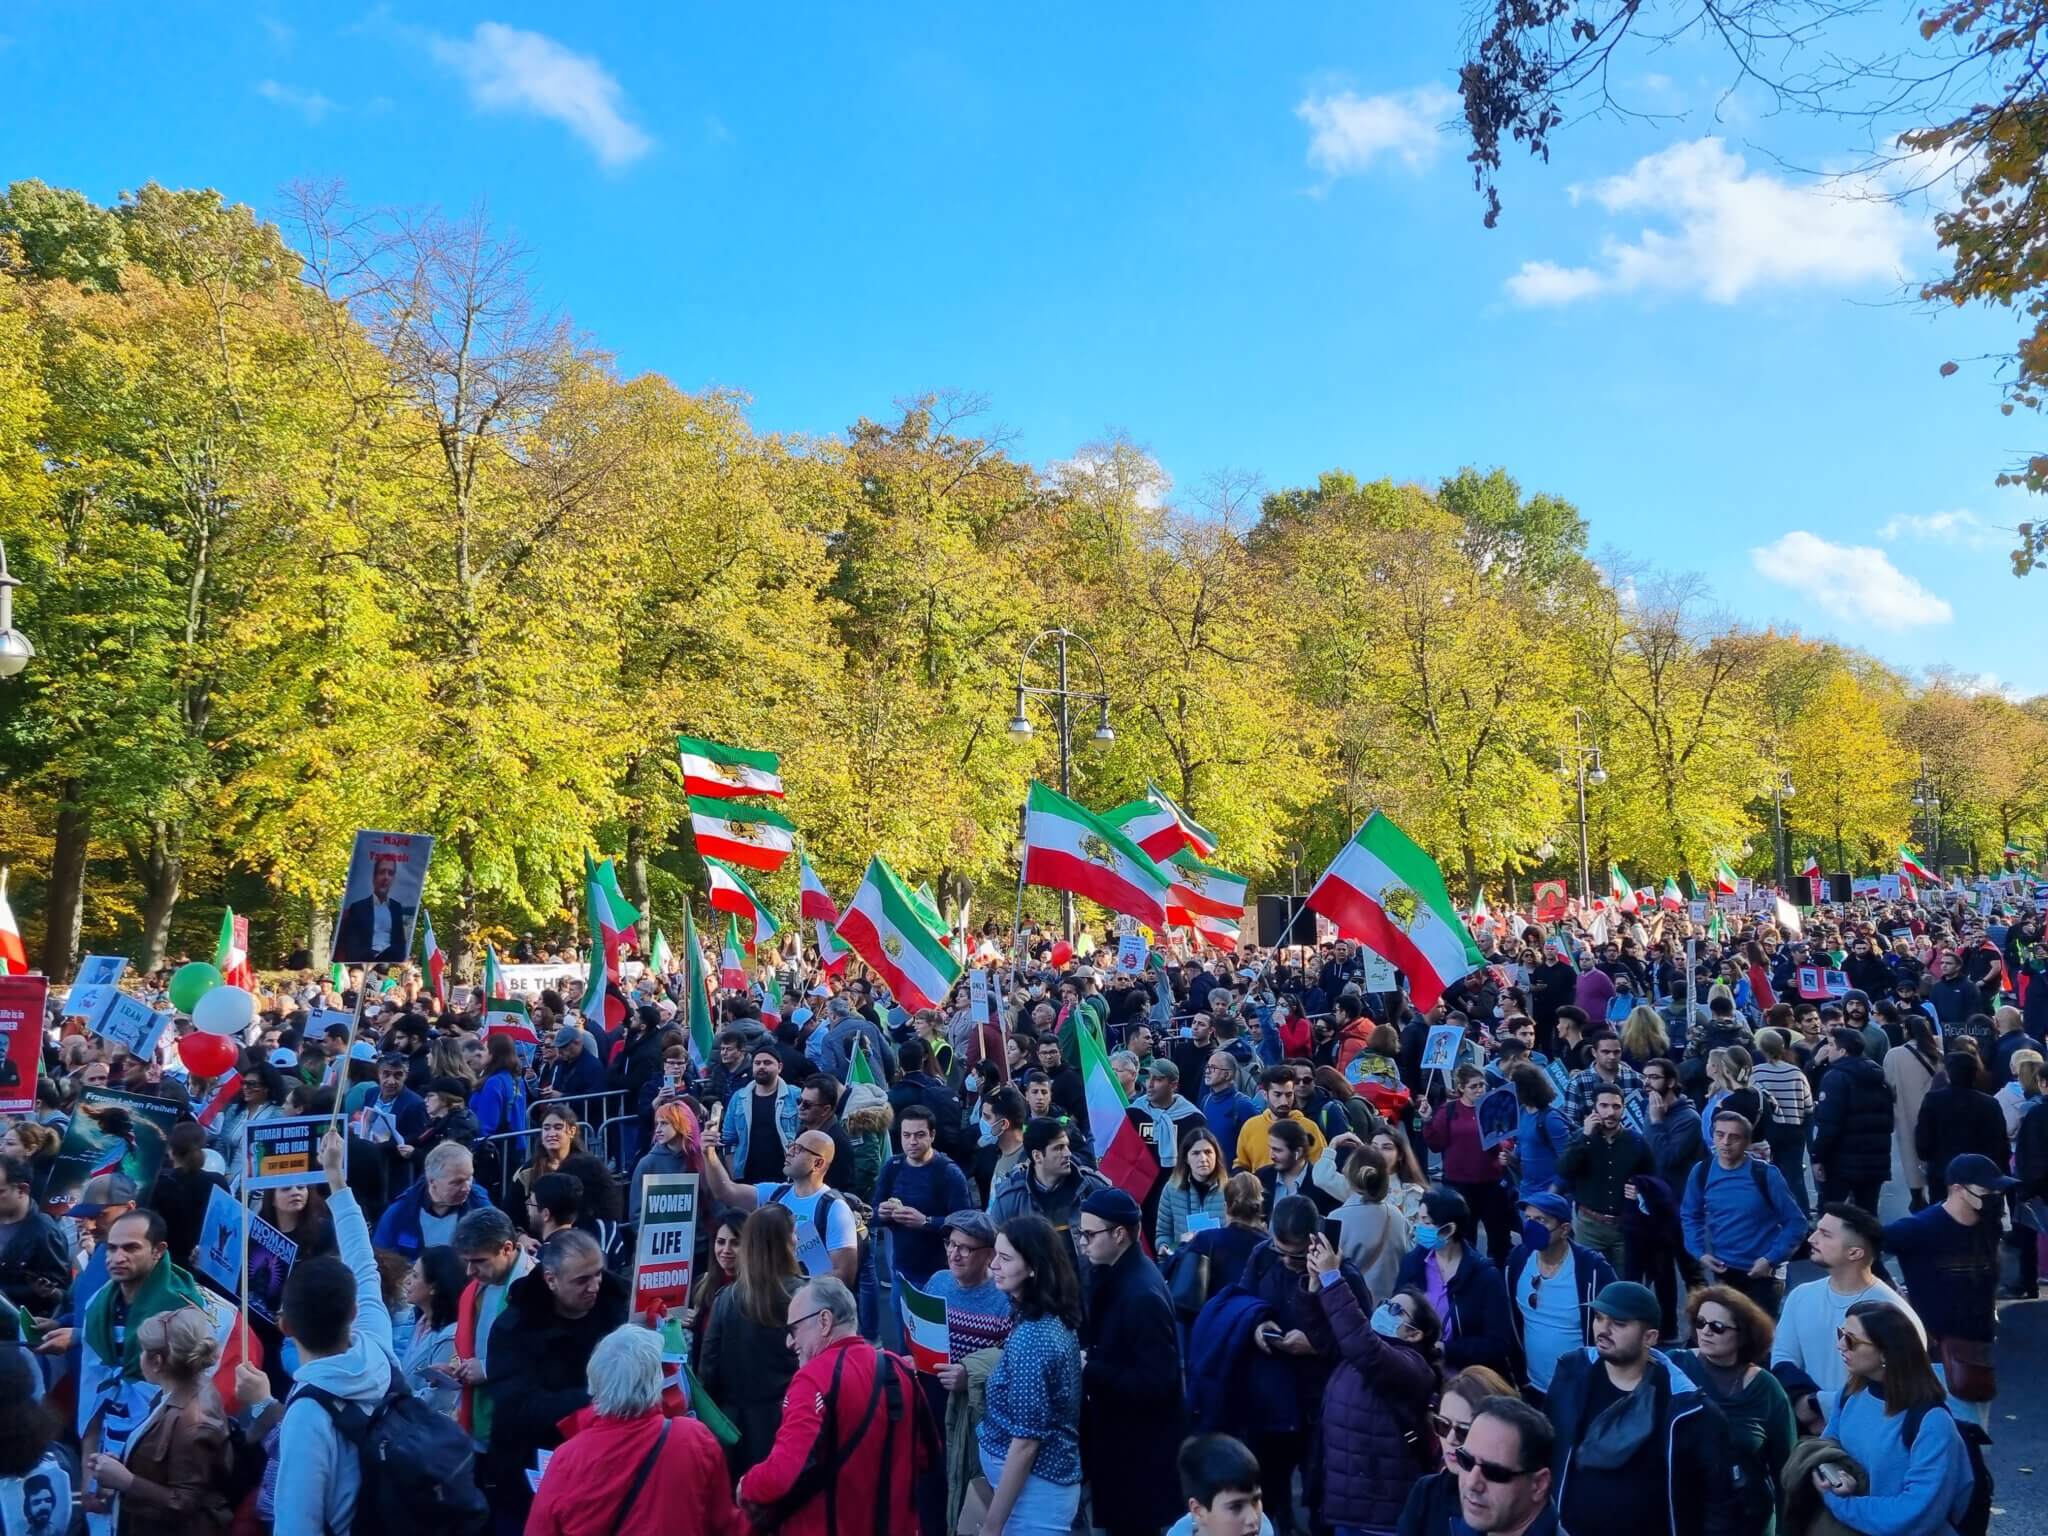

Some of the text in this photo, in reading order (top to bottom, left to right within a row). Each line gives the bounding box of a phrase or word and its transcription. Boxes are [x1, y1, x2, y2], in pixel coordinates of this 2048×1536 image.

[510, 978, 527, 990] BE
[120, 1005, 143, 1020] IRAN
[145, 1102, 178, 1115] Freiheit
[254, 1125, 310, 1141] HUMAN RIGHTS
[275, 1140, 309, 1154] FOR IRAN
[649, 1194, 692, 1213] WOMEN
[254, 1219, 296, 1258] WOMAN
[652, 1231, 682, 1255] LIFE
[639, 1269, 688, 1290] FREEDOM
